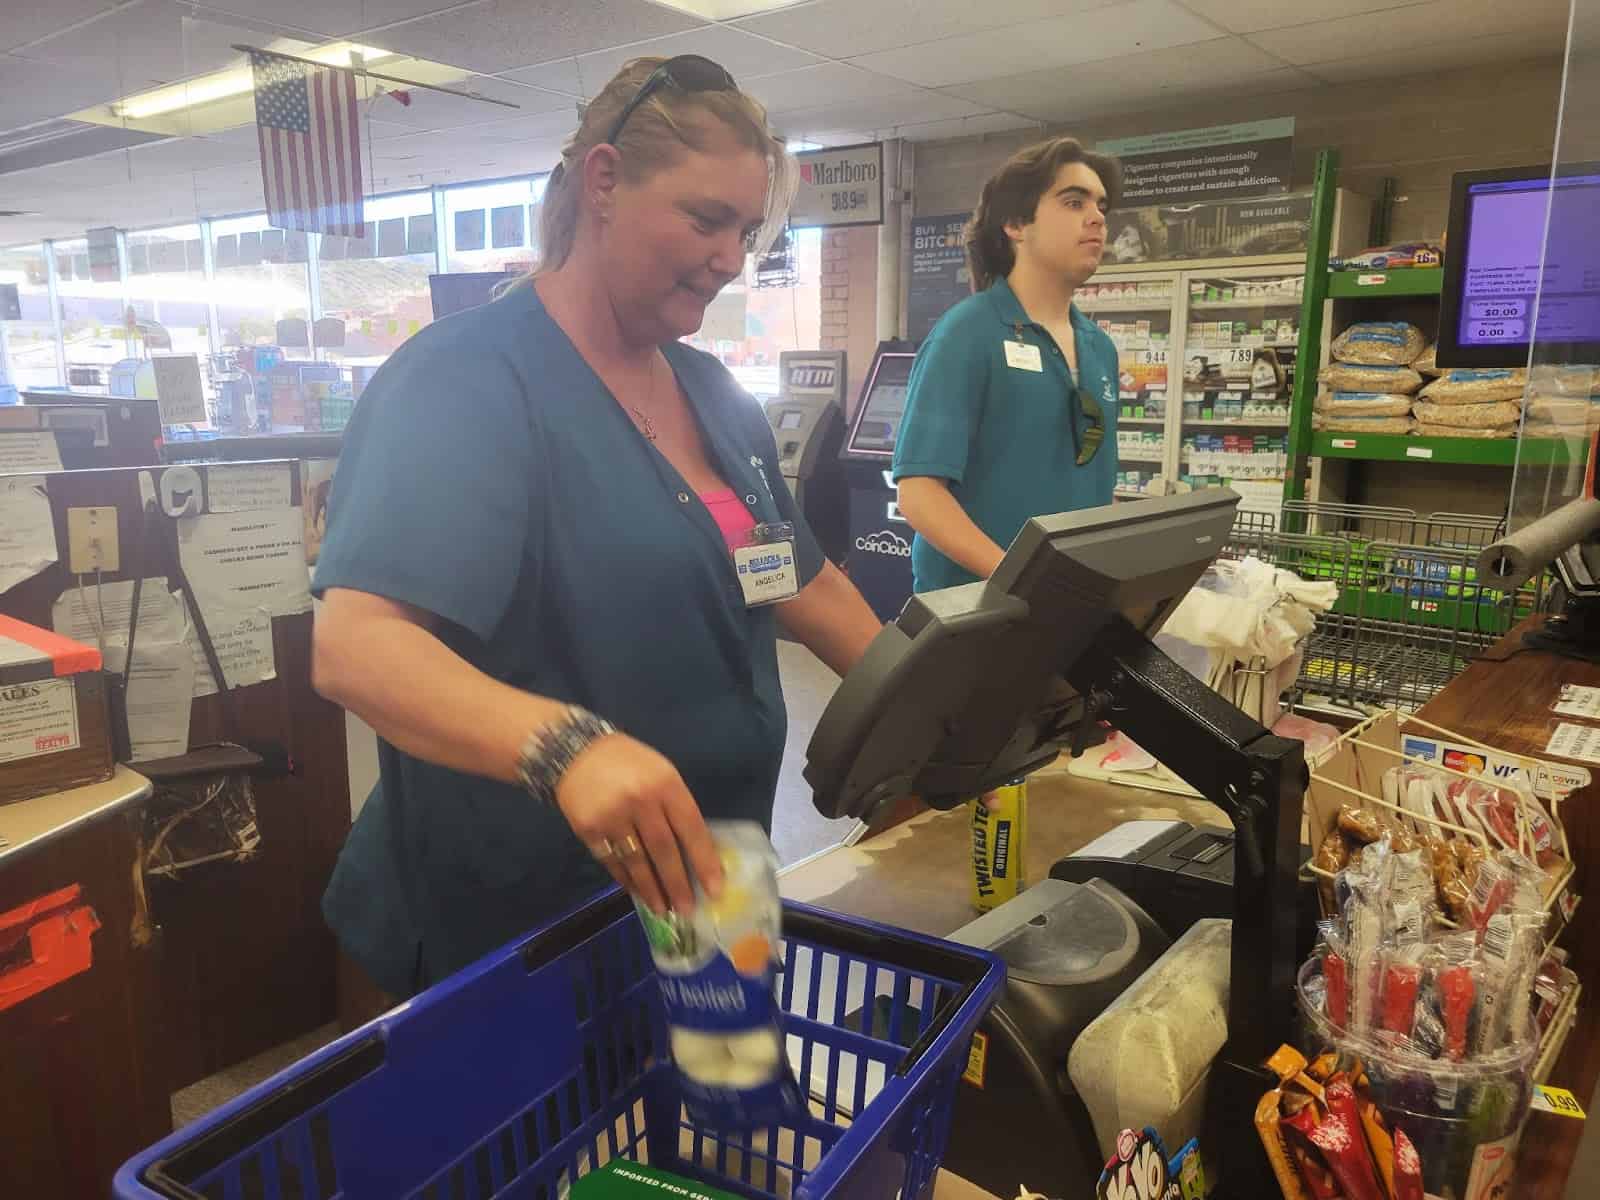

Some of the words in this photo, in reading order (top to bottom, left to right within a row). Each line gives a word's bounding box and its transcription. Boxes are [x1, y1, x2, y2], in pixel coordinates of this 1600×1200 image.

[1161, 158, 1202, 170] companies
[1204, 150, 1259, 165] intentionally
[813, 161, 877, 184] Marlboro
[1123, 174, 1157, 186] designed
[1158, 170, 1197, 183] cigarettes
[1198, 168, 1217, 178] with
[1218, 165, 1250, 177] enough
[1122, 187, 1154, 198] nicotine
[1155, 185, 1164, 194] to
[1164, 184, 1189, 194] create
[1190, 181, 1206, 191] and
[1206, 179, 1237, 190] sustain
[1238, 175, 1281, 187] addiction.
[915, 224, 936, 236] BUY
[1478, 328, 1505, 338] 0.00
[789, 367, 835, 387] ATM
[855, 536, 911, 557] CoinCloud
[754, 574, 785, 588] ANGELICA
[1539, 771, 1581, 786] DICOVER
[996, 828, 1008, 870] ORIGINAL
[975, 826, 994, 897] TWISTED
[1543, 1092, 1580, 1112] 0.99
[612, 1167, 660, 1186] IMPORTED
[660, 1182, 689, 1196] FROM
